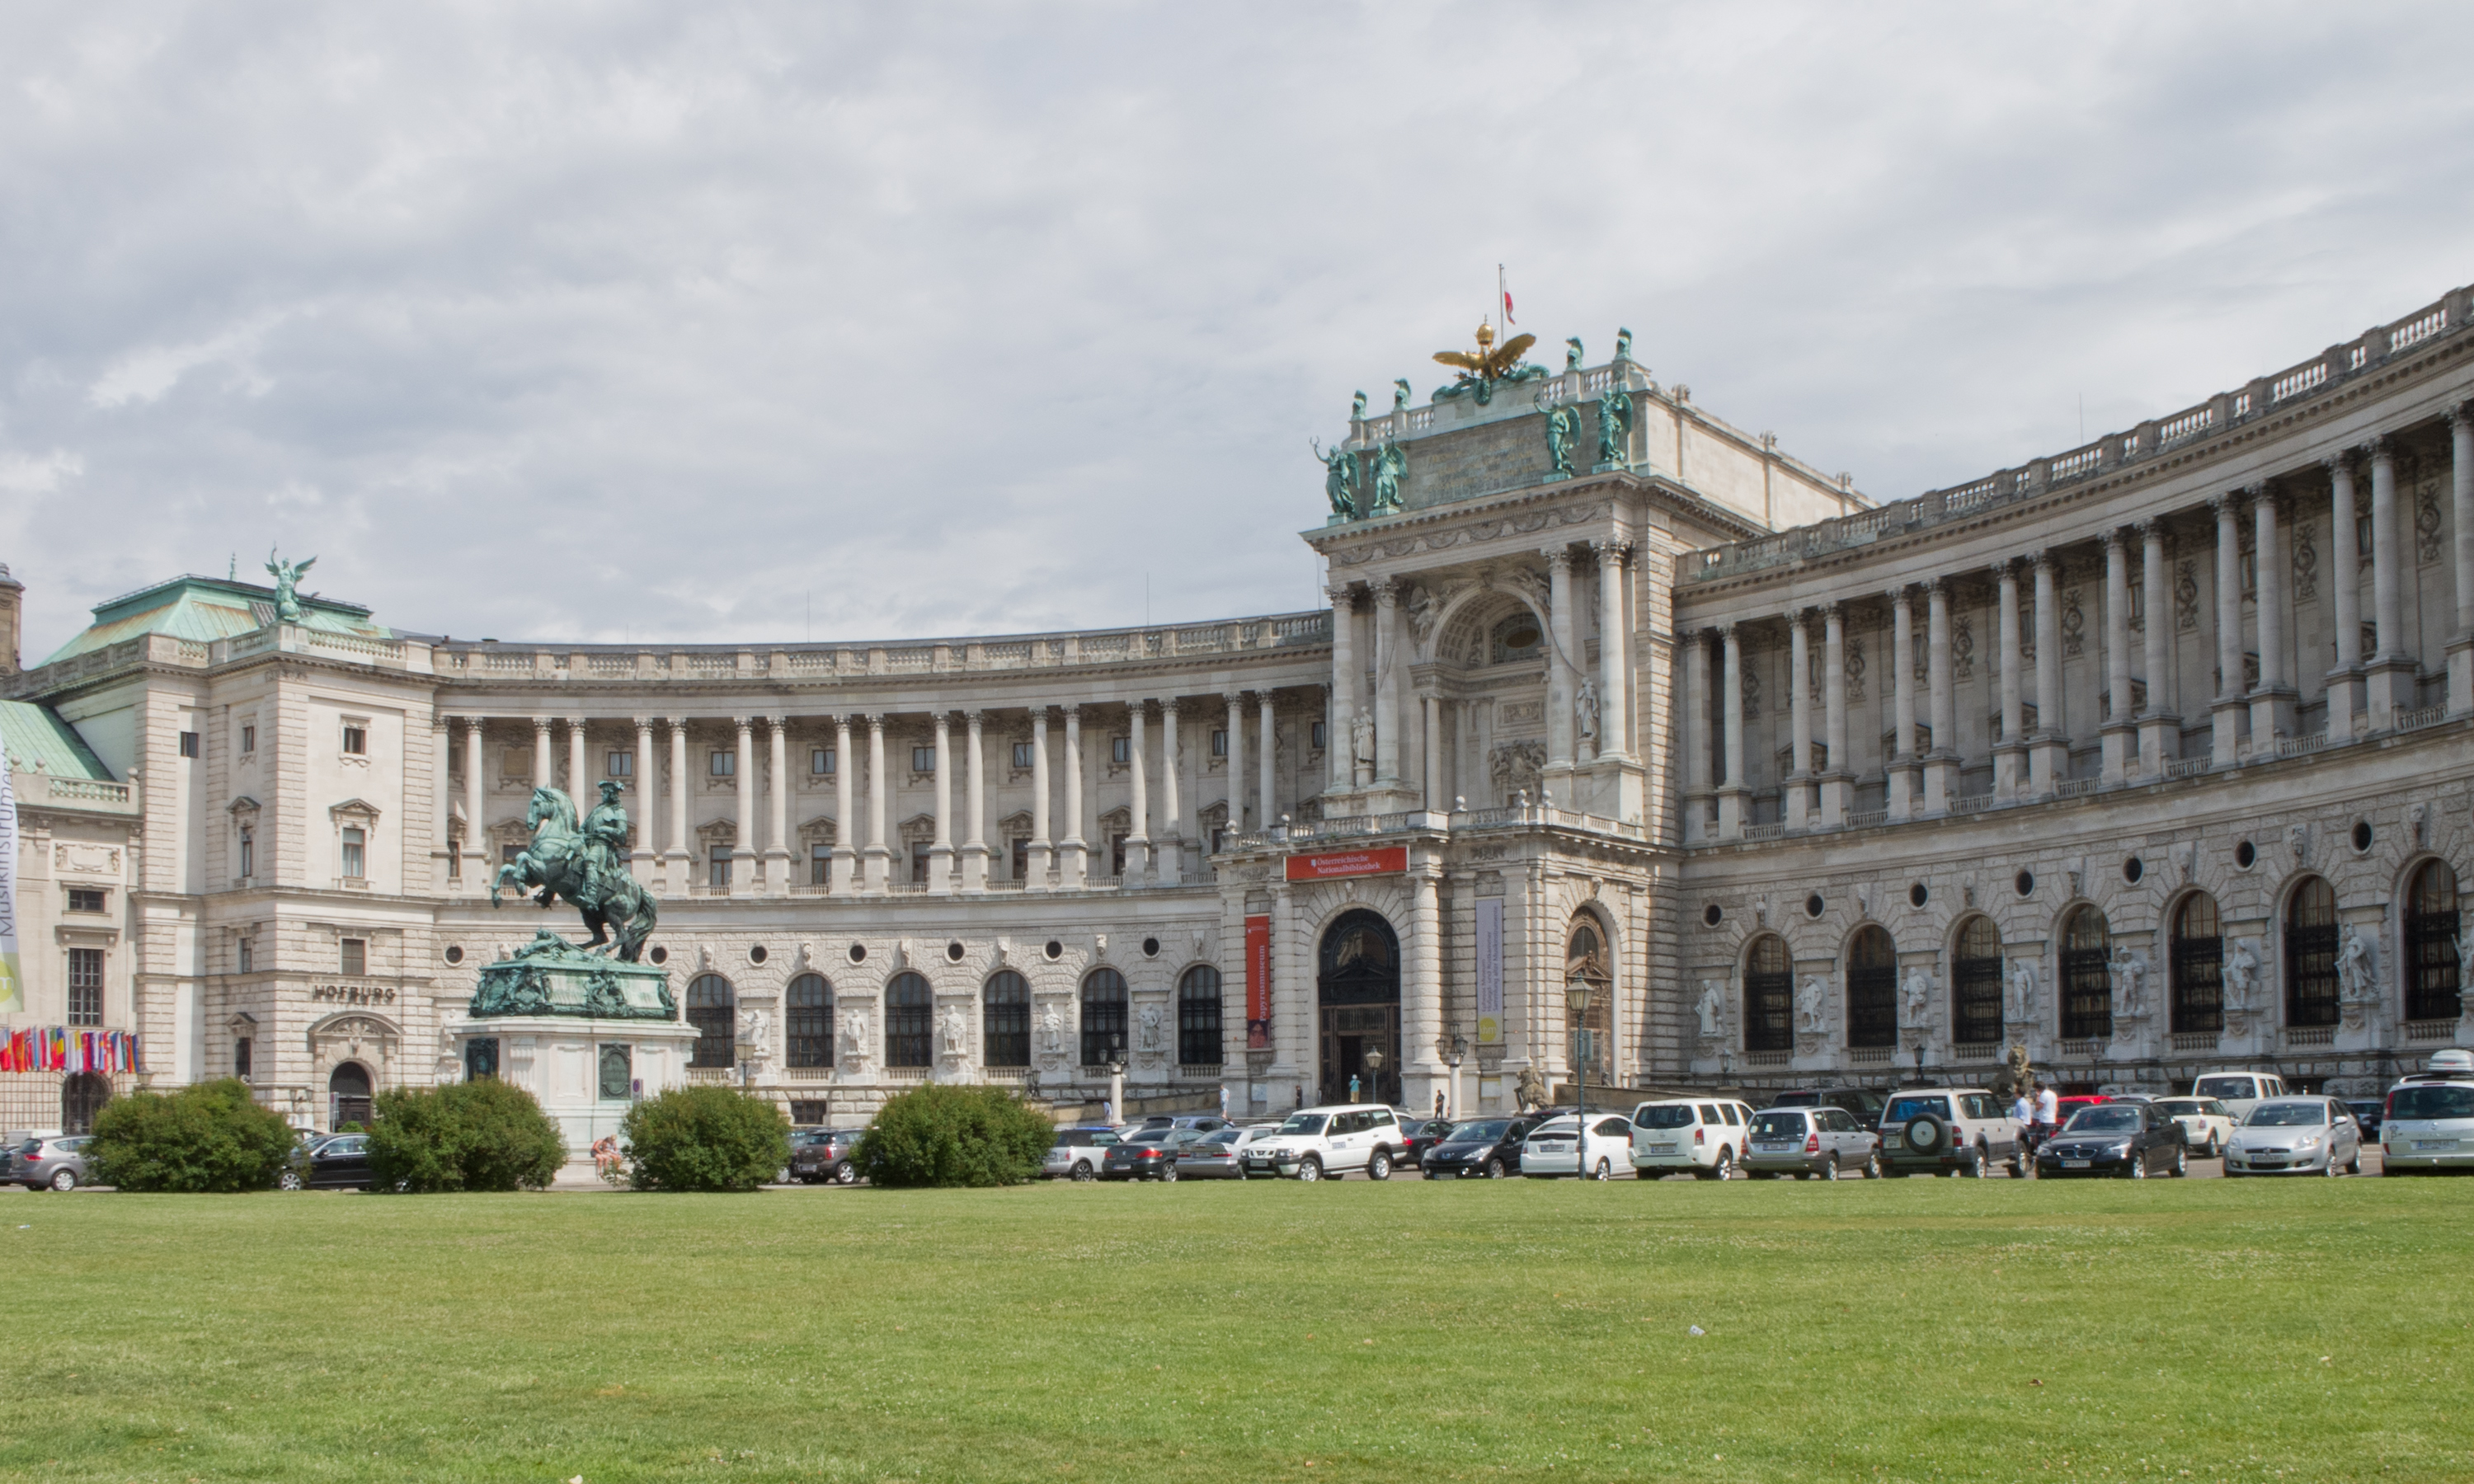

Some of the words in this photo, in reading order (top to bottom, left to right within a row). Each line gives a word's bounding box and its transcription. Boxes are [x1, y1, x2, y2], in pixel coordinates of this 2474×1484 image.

[1317, 855, 1368, 866] Österreichische
[1317, 862, 1380, 875] Nationalbibliothek
[314, 984, 396, 1000] HOFBURG
